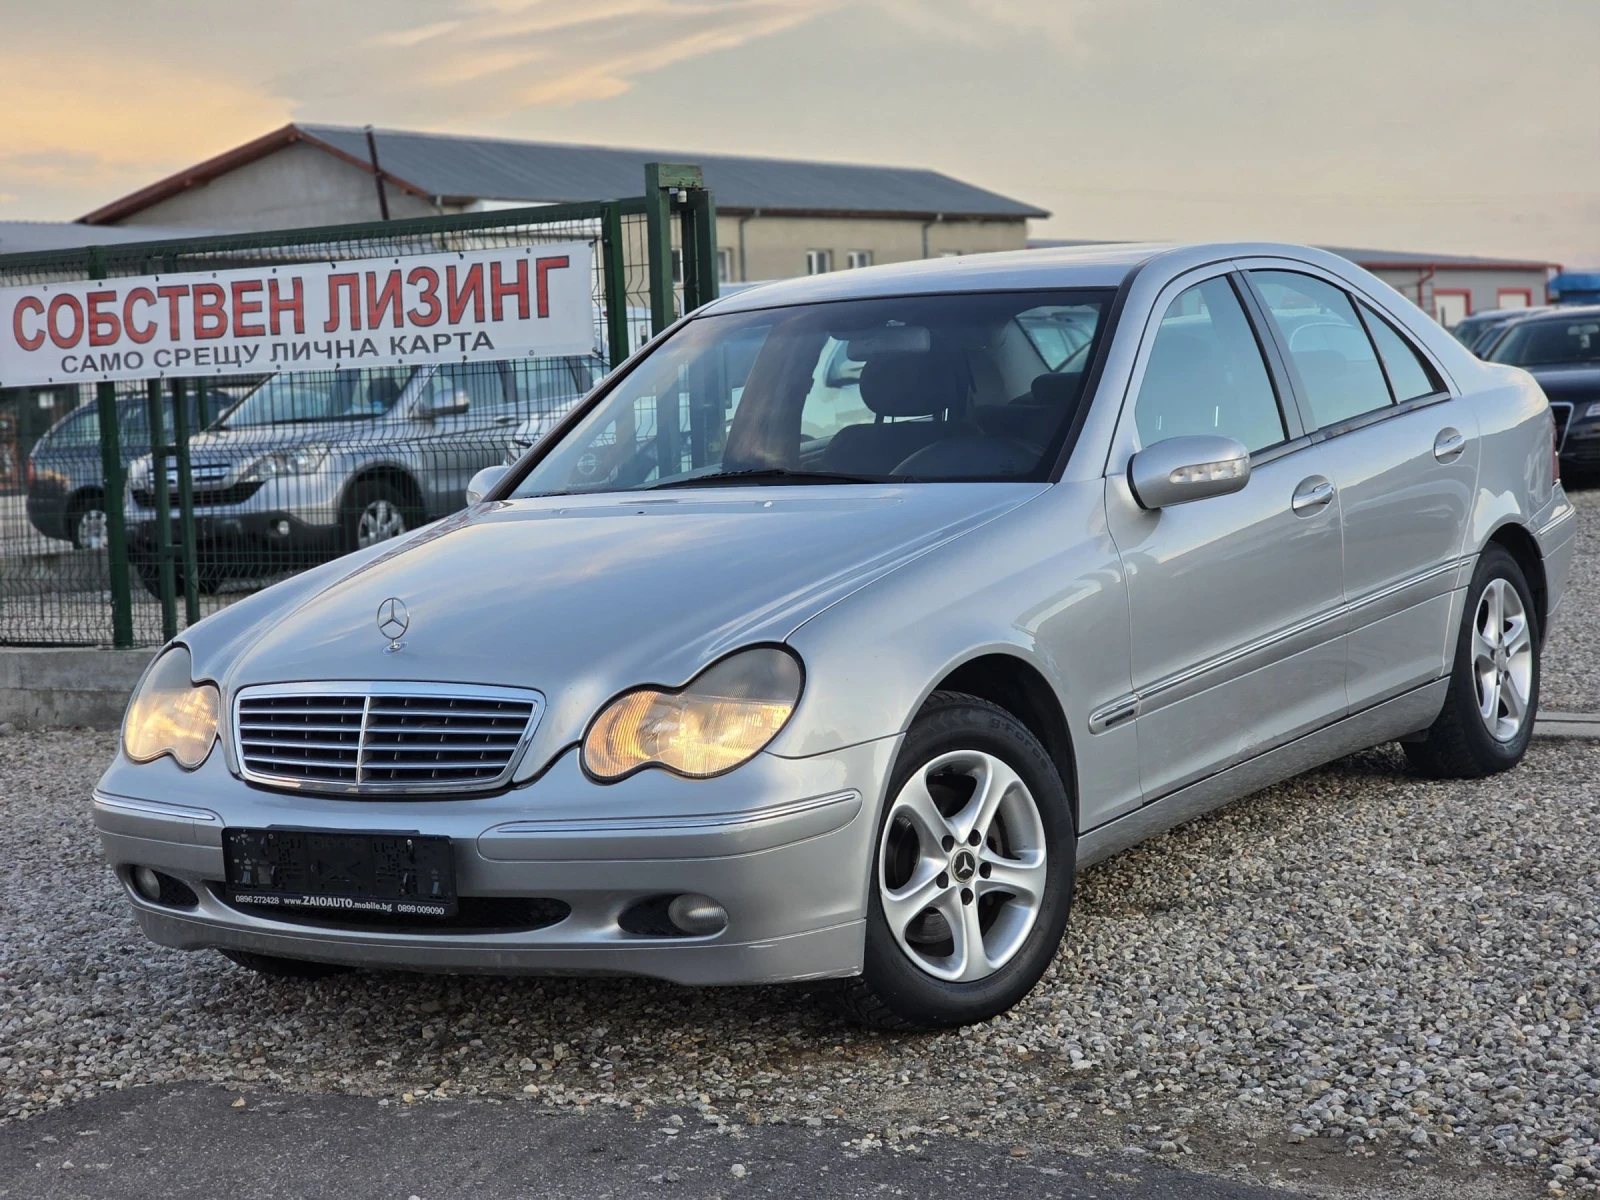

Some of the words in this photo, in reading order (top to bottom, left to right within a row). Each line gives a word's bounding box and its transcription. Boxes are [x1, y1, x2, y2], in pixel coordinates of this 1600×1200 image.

[13, 277, 305, 351] СОБСТВЕН
[324, 255, 570, 333] ЛИЗИНГ
[61, 351, 144, 373] САМО
[153, 344, 260, 368] СРЕЩУ
[269, 338, 379, 362] ЛИЧНА
[390, 331, 495, 355] КАРТА
[235, 895, 253, 903] 0896
[253, 896, 280, 905] 272428
[284, 896, 393, 912] www.ZAIOAUTO.mobile.bg
[397, 904, 416, 913] 0899
[417, 905, 445, 915] 009090
